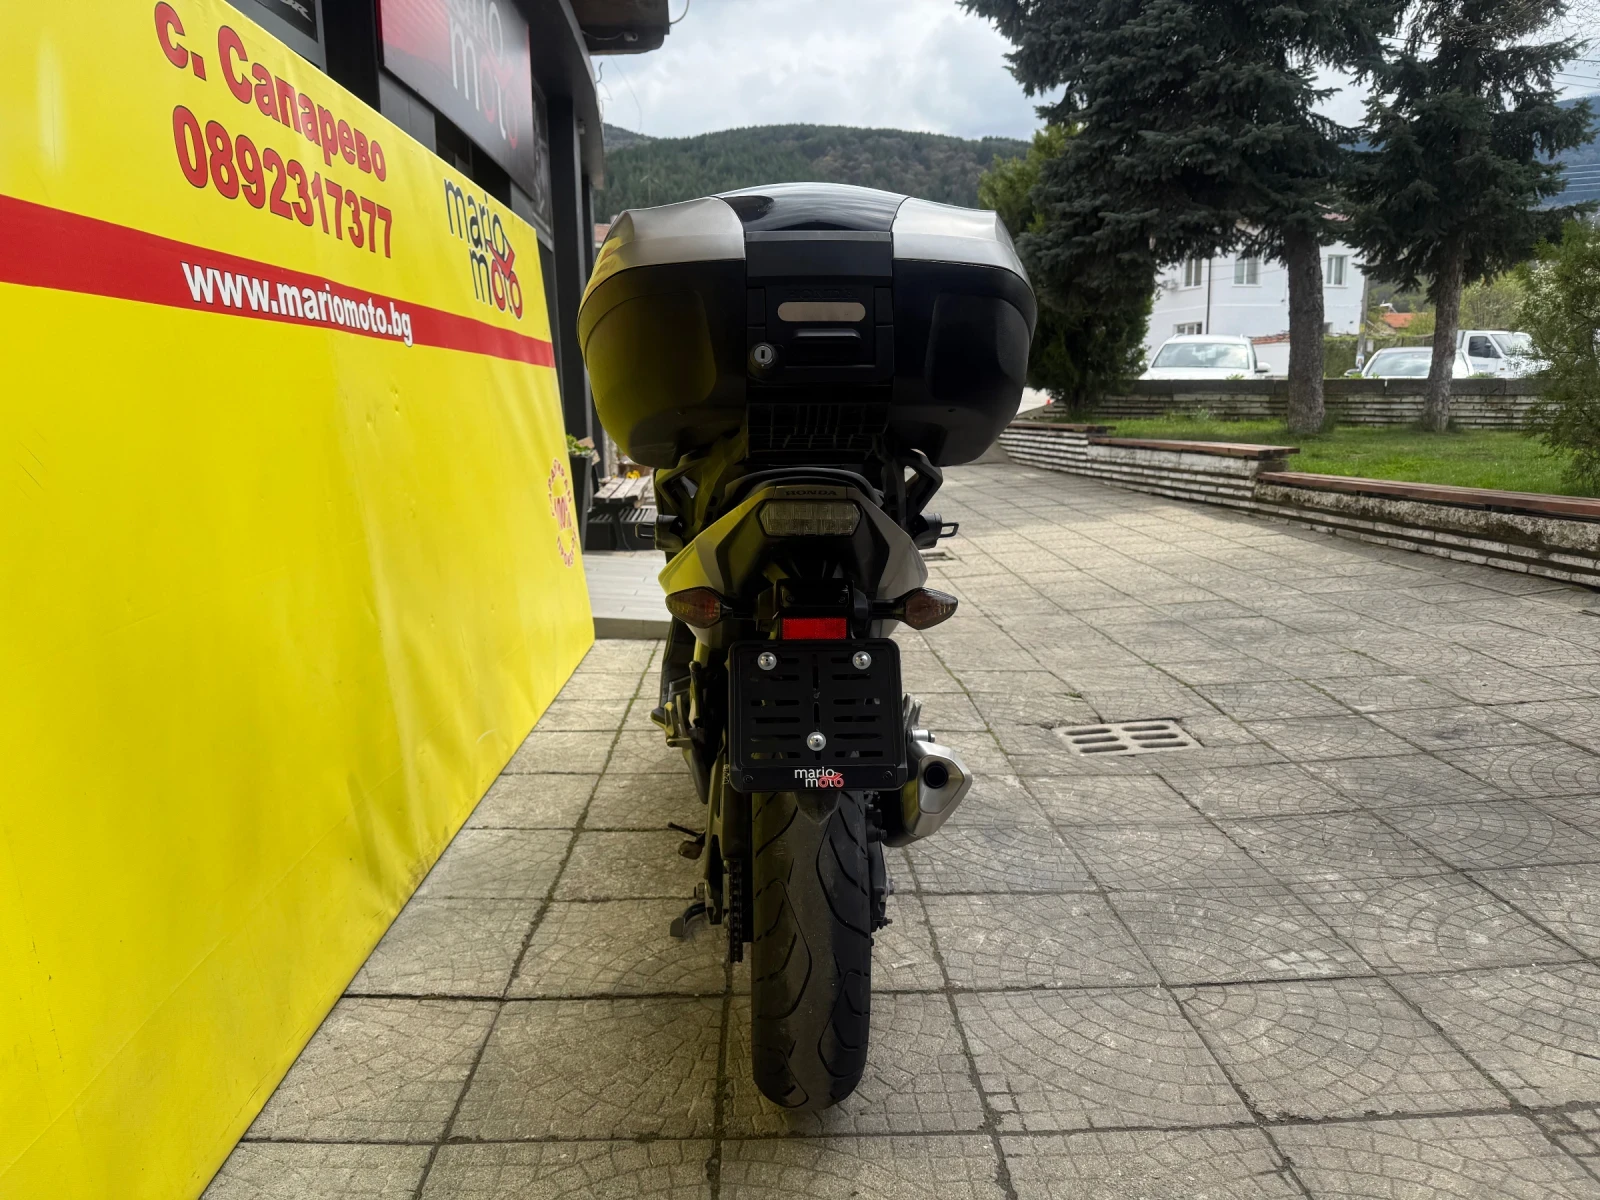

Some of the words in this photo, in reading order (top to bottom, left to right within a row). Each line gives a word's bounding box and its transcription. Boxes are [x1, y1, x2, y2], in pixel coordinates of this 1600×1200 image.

[218, 25, 387, 182] Сапарево
[172, 105, 393, 258] 0892317377
[444, 178, 507, 260] mario
[181, 261, 413, 347] www.mariomoto.bg
[469, 247, 523, 320] moto
[794, 766, 835, 779] mario
[805, 777, 845, 788] moto
